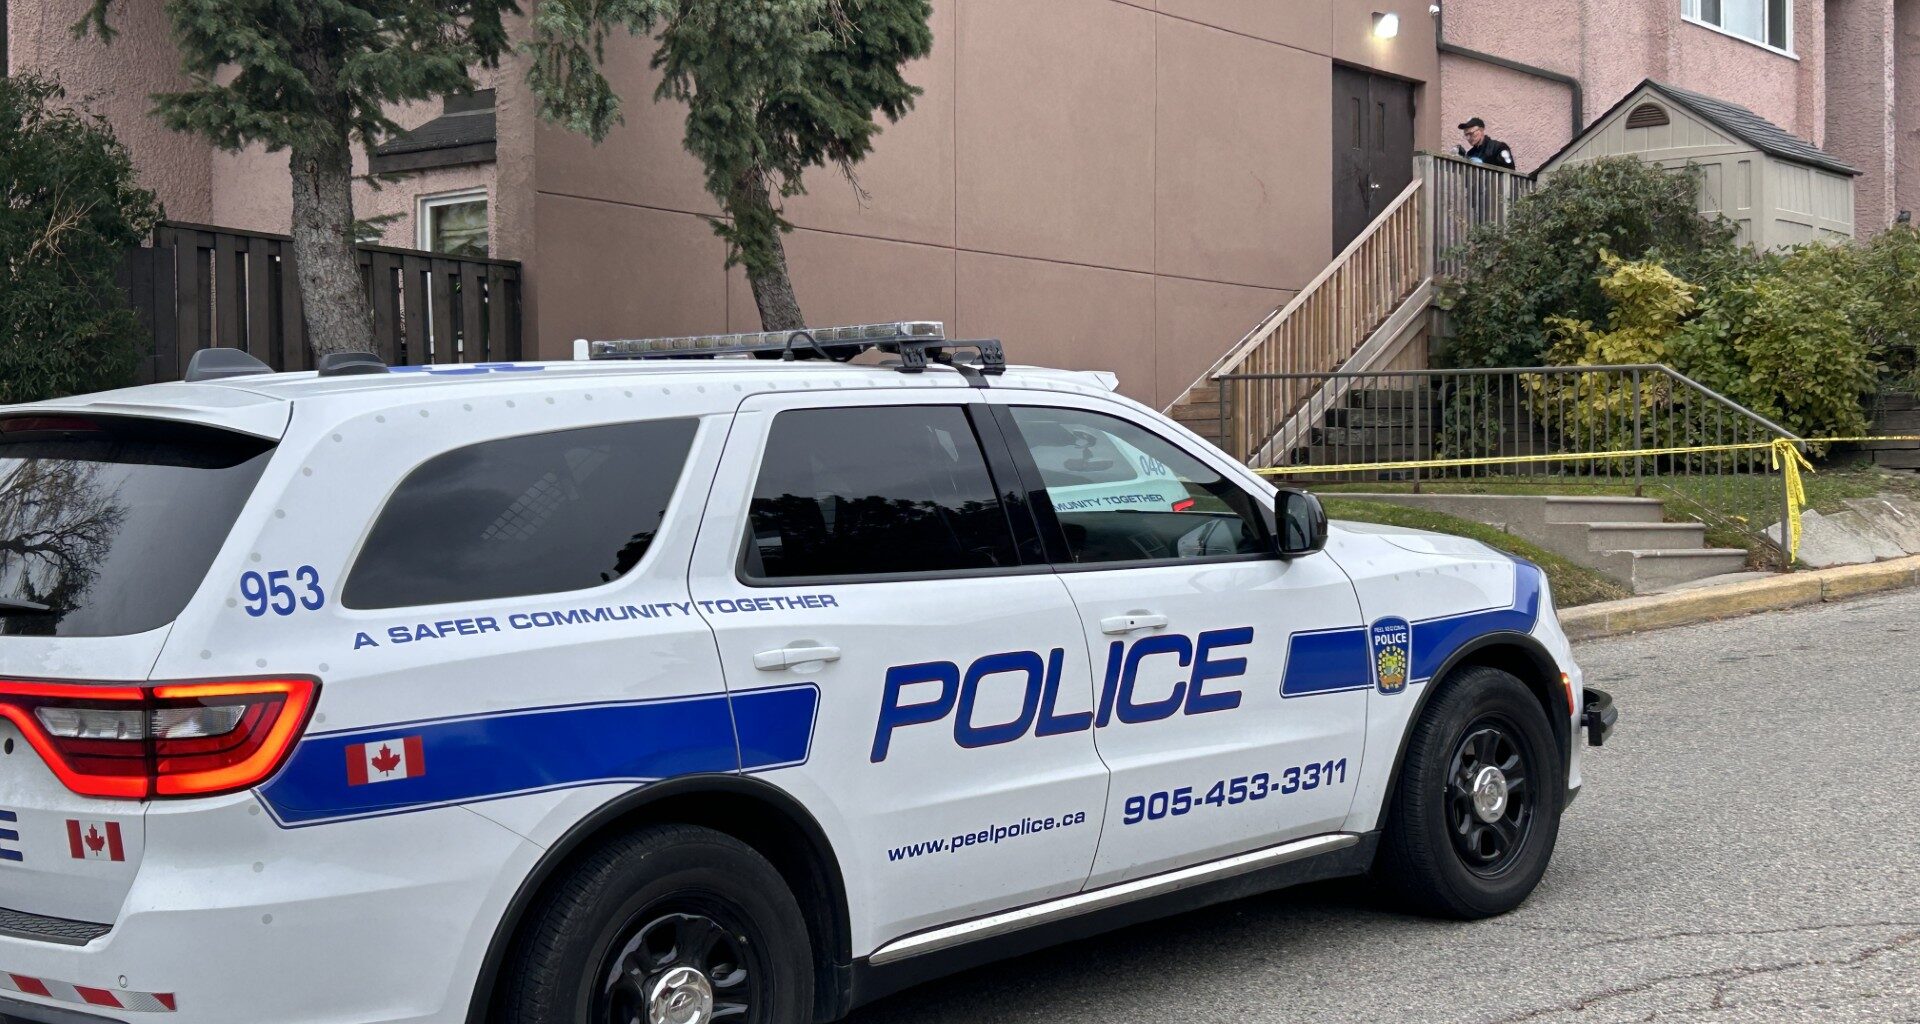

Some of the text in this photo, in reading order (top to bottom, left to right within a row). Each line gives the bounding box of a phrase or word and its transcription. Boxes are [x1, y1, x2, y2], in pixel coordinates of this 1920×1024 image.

[1103, 494, 1166, 505] TOGETHER
[239, 564, 325, 617] 953
[353, 594, 839, 650] A SAFER COMMUNITY TOGETHER
[1374, 632, 1407, 646] POLICE
[870, 626, 1254, 763] POLICE
[1122, 758, 1347, 825] 905-453-3311
[887, 810, 1086, 861] www.peelpolice.ca
